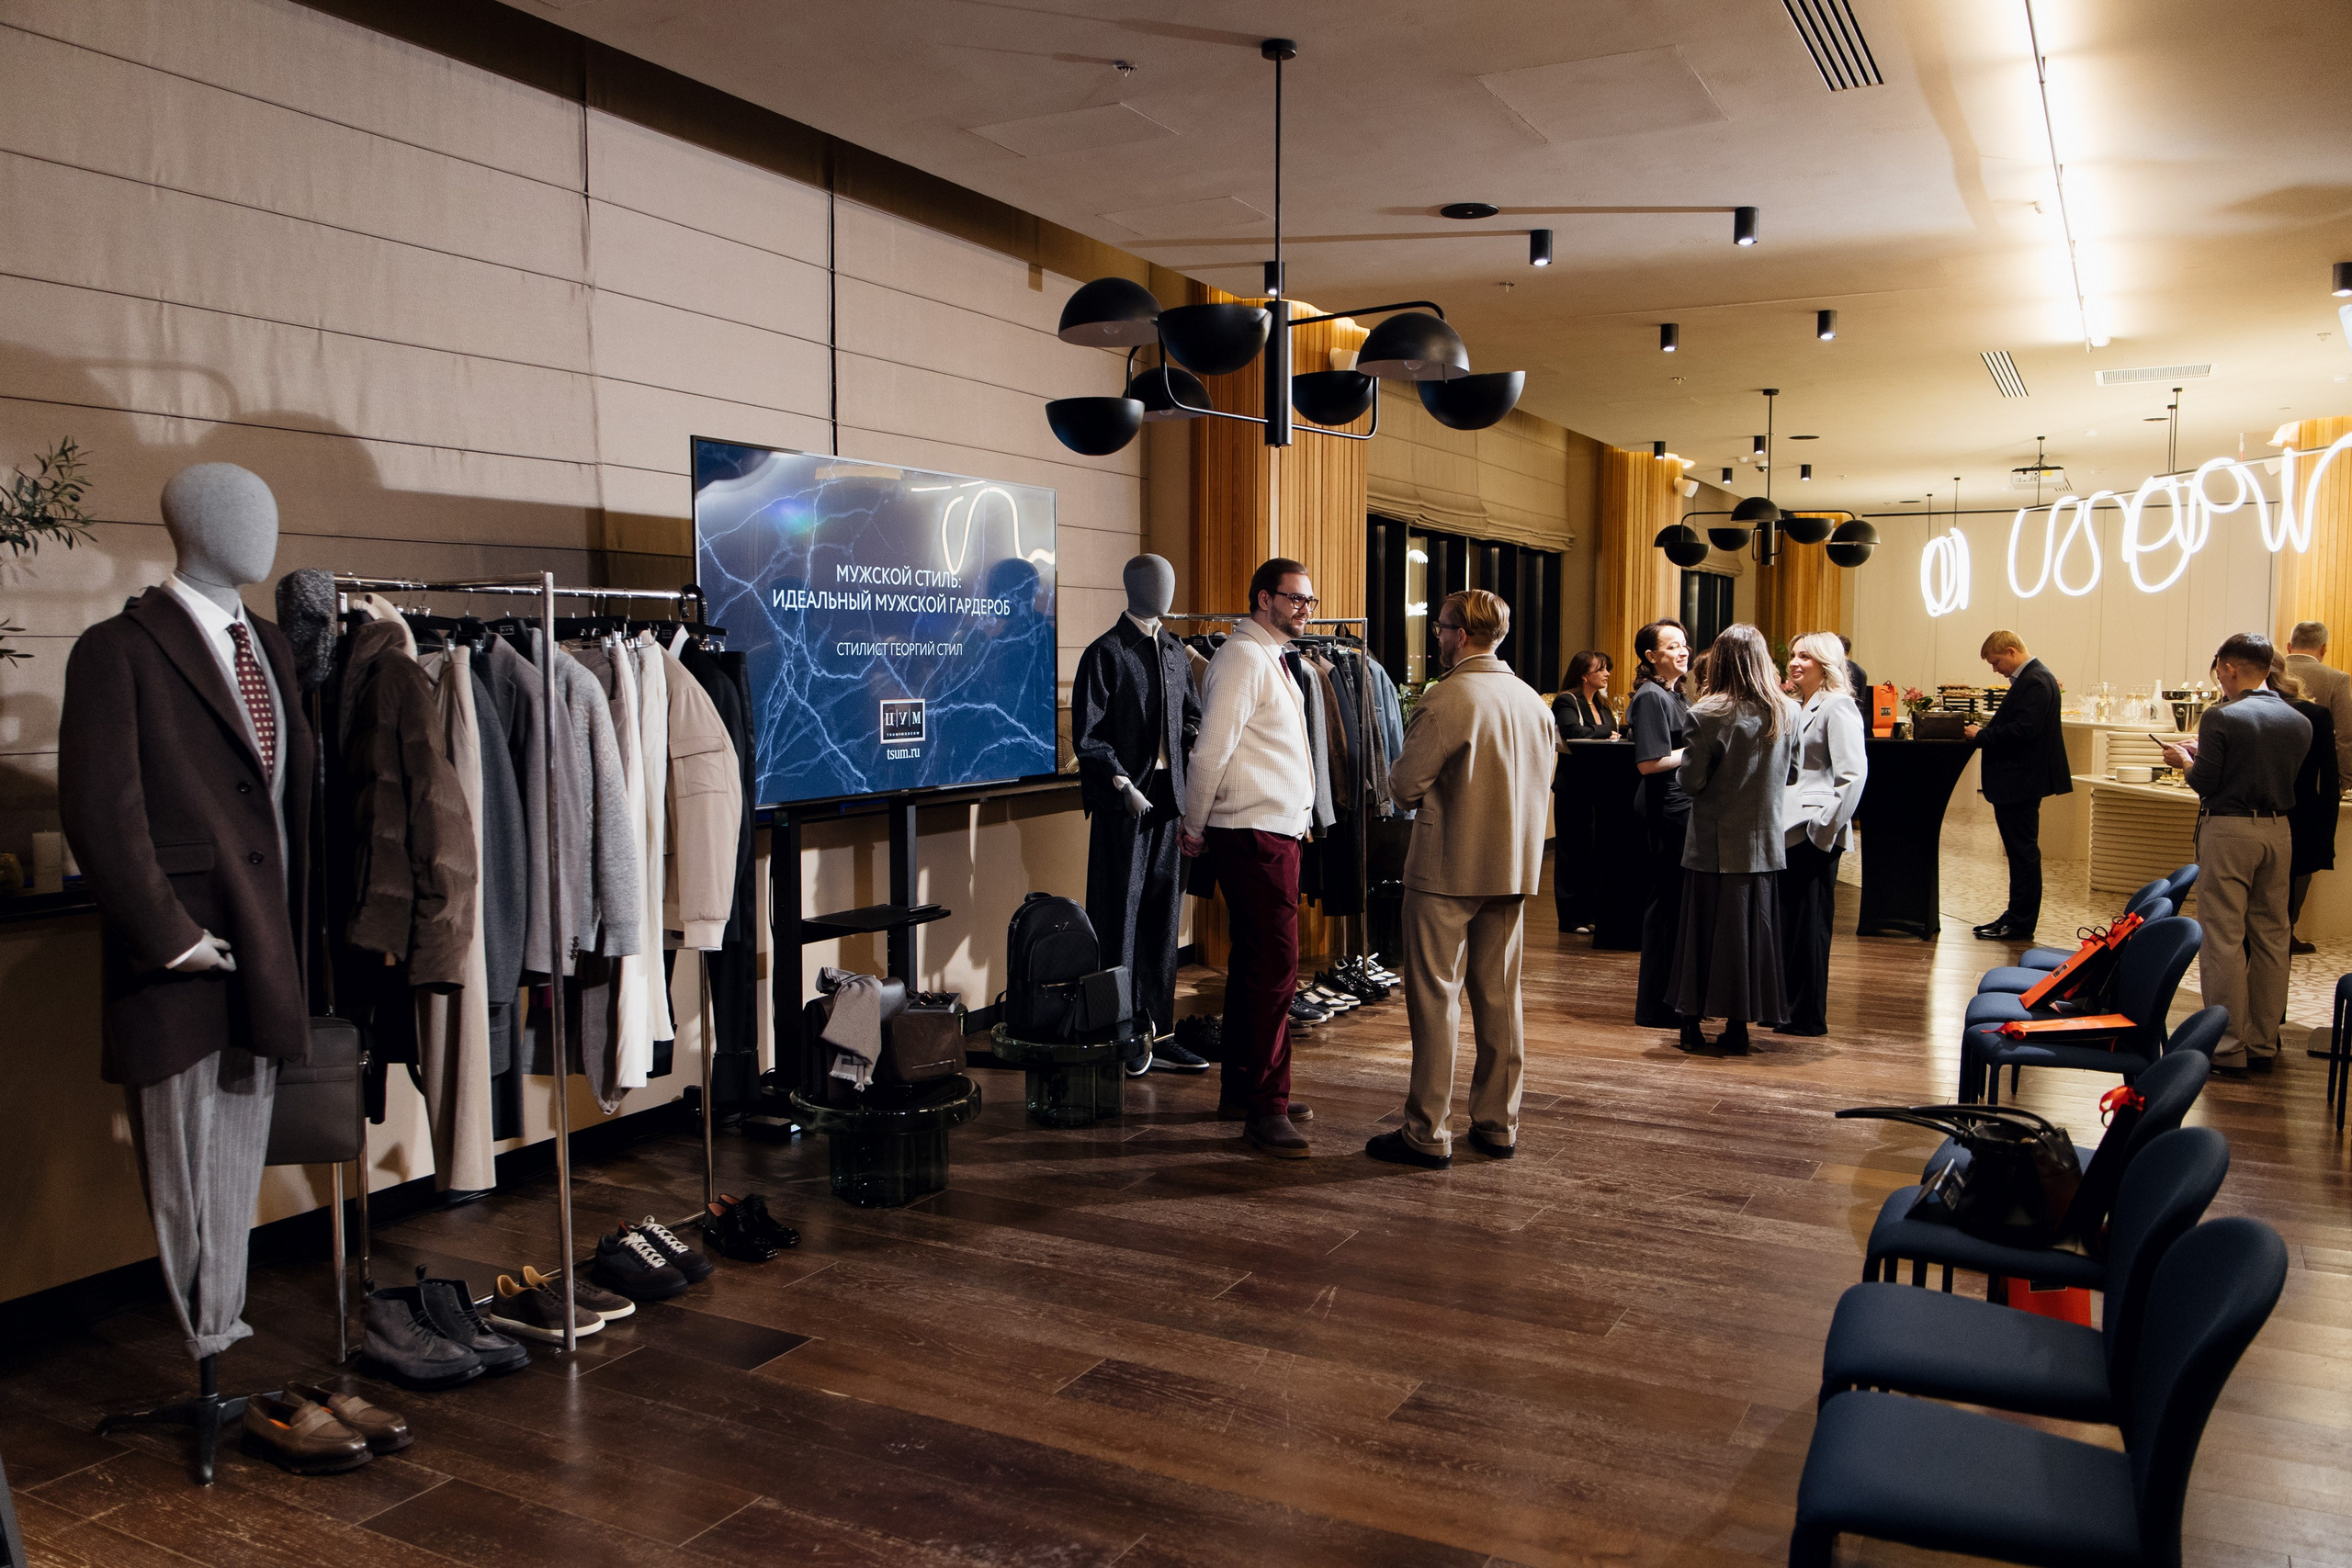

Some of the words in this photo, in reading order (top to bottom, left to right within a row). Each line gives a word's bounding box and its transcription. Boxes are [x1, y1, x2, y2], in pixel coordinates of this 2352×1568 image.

[836, 564, 911, 586] МУЖСКОЙ
[914, 570, 962, 589] СТИЛЬ:
[773, 589, 872, 612] ИДЕАЛЬНЫЙ
[876, 592, 946, 614] МУЖСКОЙ
[949, 597, 1011, 617] ГАРДЕРОБ
[836, 642, 888, 656] СТИЛИСТ
[890, 640, 935, 657] ГЕОРГИЙ
[936, 643, 963, 656] СТИЛ
[887, 748, 921, 760] tsum.ru
